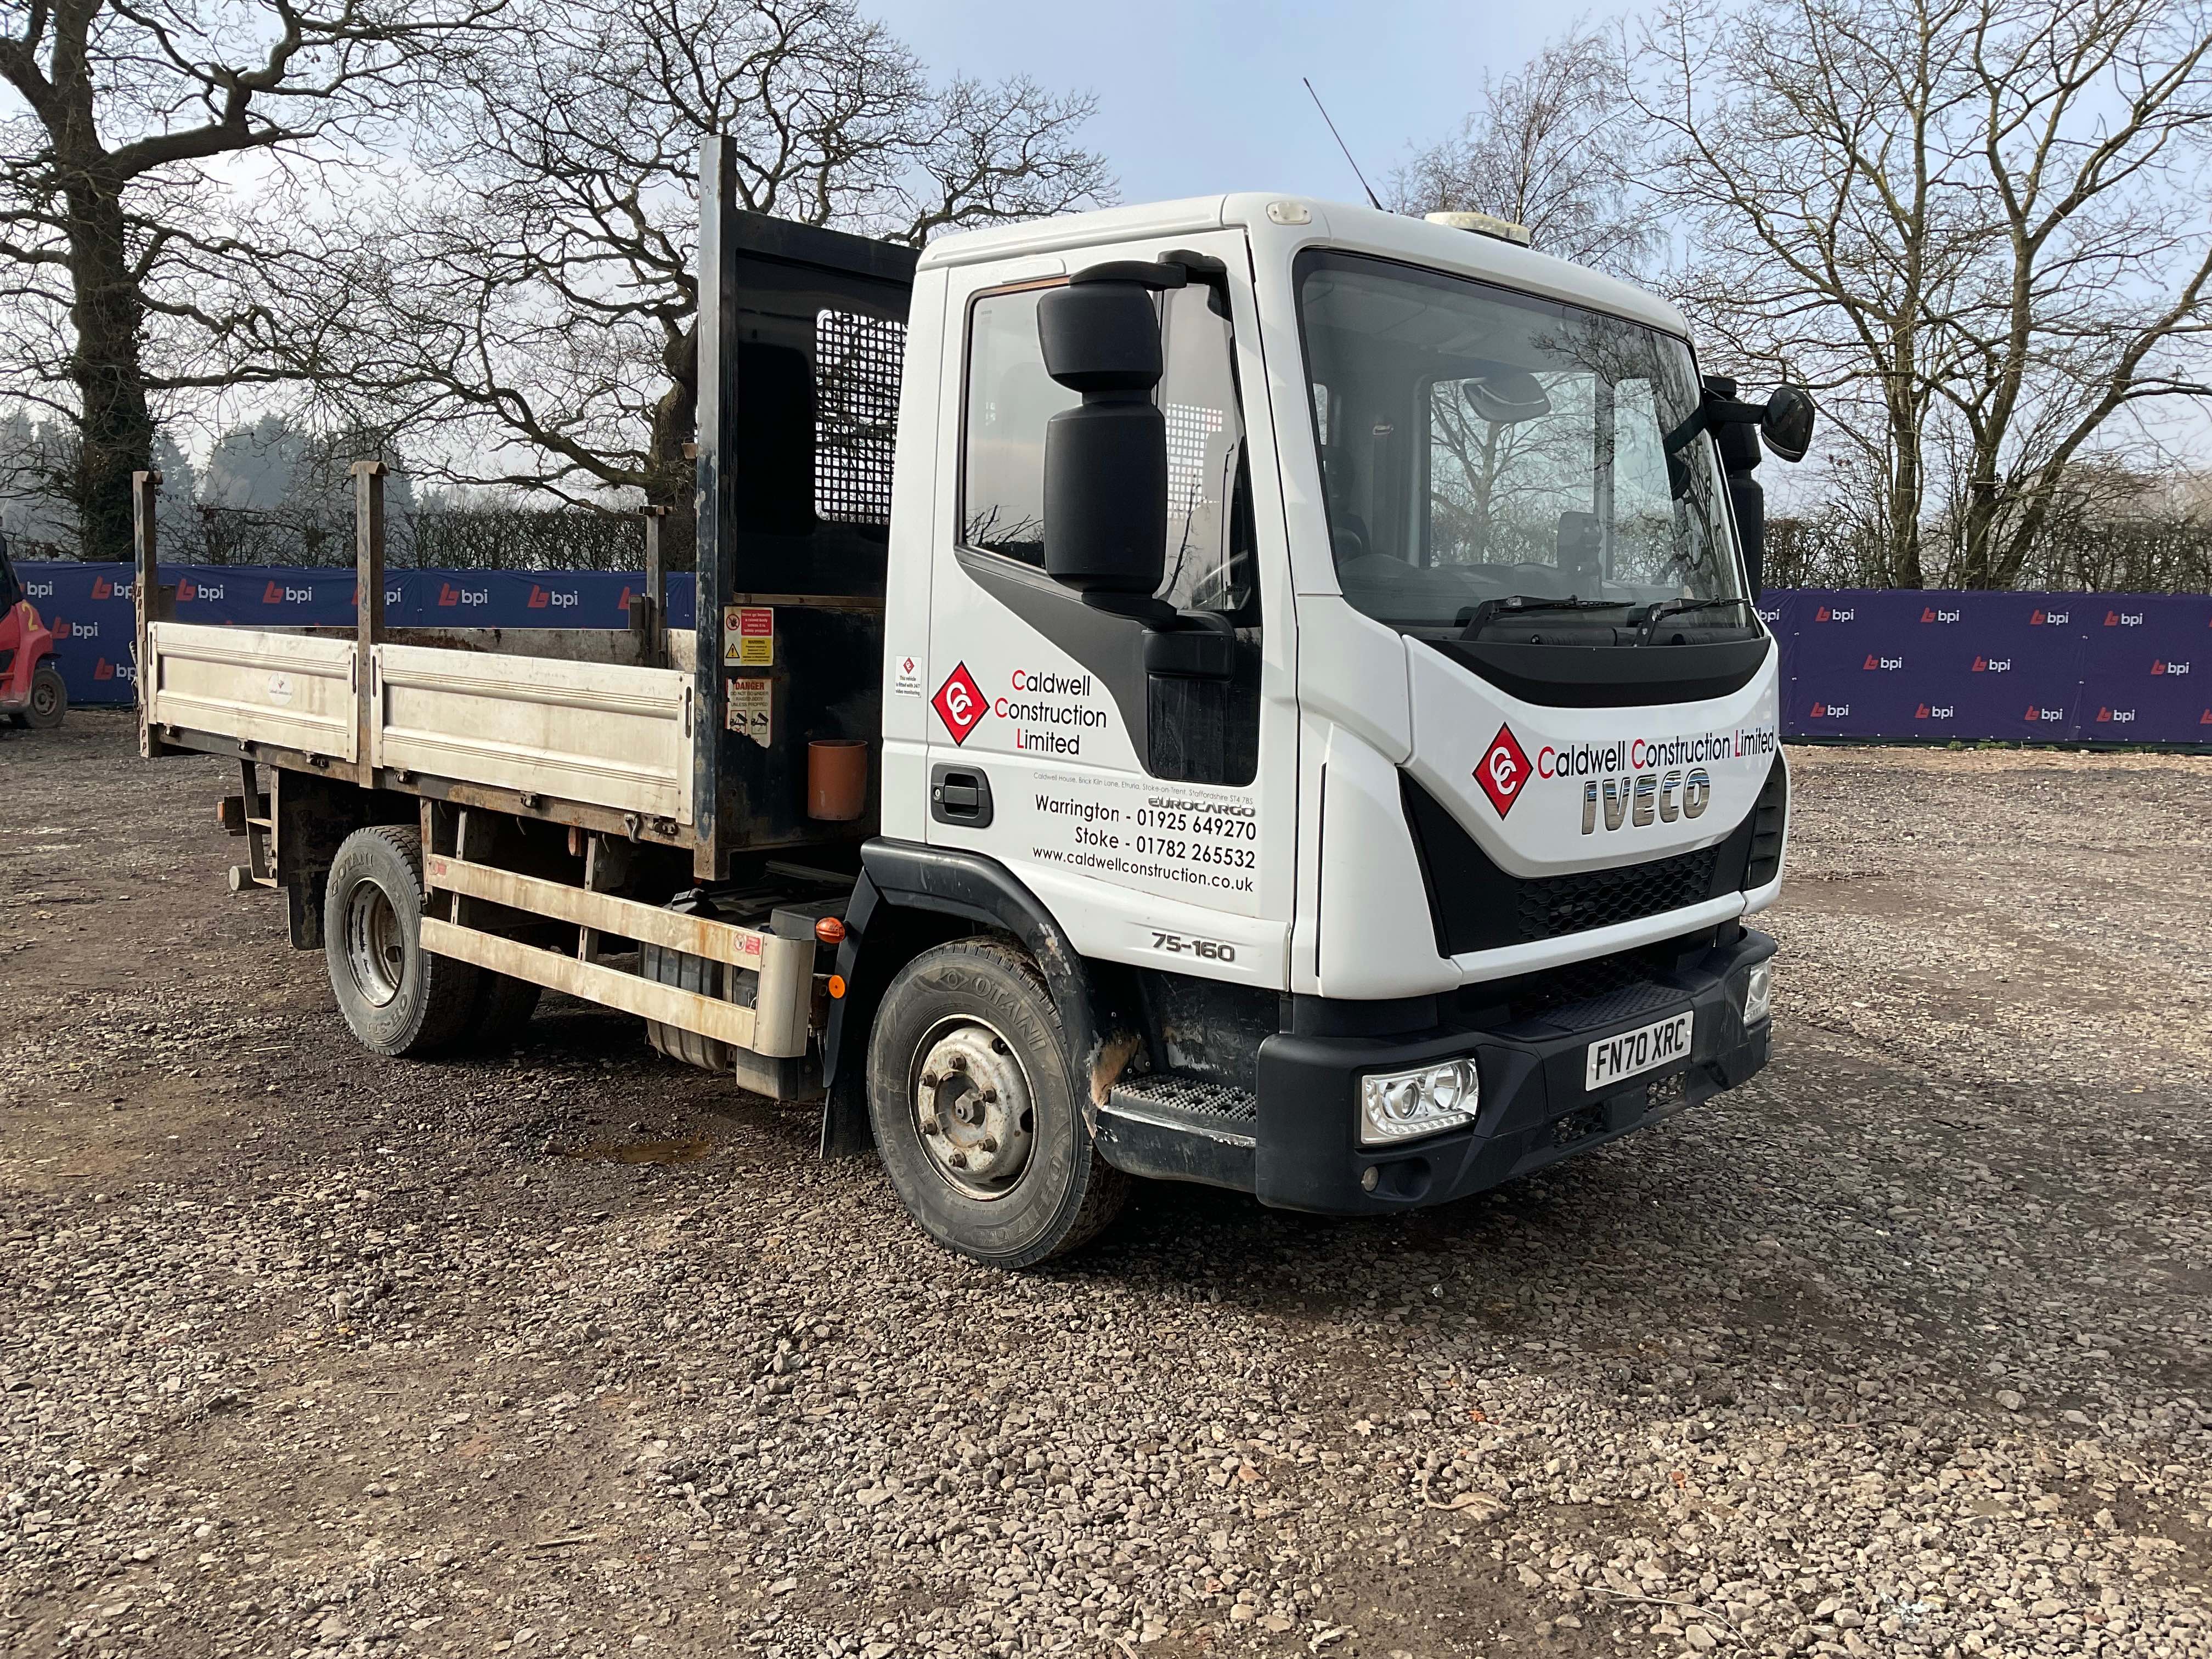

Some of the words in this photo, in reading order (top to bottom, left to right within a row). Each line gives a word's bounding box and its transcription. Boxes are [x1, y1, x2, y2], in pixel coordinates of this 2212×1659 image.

[27, 581, 53, 598] bpi
[114, 582, 133, 599] bp
[198, 584, 224, 601] bpi
[286, 586, 312, 603] bpi
[384, 588, 401, 605] pi
[461, 589, 488, 606] bpi
[551, 591, 578, 608] bpi
[21, 602, 38, 631] 2
[1759, 608, 1780, 622] bpi
[1832, 608, 1854, 623] bpi
[1938, 610, 1960, 623] bpi
[2047, 612, 2069, 625] bpi
[2121, 613, 2143, 627] bpi
[72, 622, 98, 639] bpi
[116, 663, 137, 680] bp
[1881, 657, 1902, 670] bpi
[1989, 659, 2011, 673] bpi
[2168, 662, 2190, 675] bpi
[736, 682, 764, 690] DANGER
[1012, 669, 1090, 696] Caldwell
[995, 697, 1107, 727] Construction
[1827, 704, 1849, 718] bpi
[1932, 706, 1954, 719] bpi
[2041, 708, 2063, 722] bpi
[2113, 709, 2135, 723] bpi
[1017, 728, 1080, 755] Limited
[1538, 741, 1625, 779] Caldwell
[1632, 732, 1730, 769] Construction
[1735, 726, 1774, 757] Limited
[1034, 772, 1057, 781] Caldwell
[1121, 781, 1141, 791] Etruria,
[1189, 789, 1228, 802] Staffordshire
[1148, 796, 1256, 817] EUROCARGO
[1582, 768, 1710, 835] IVECO
[1036, 794, 1119, 822] Warrington
[1137, 809, 1186, 831] 01925
[1193, 816, 1256, 840] 649270
[1075, 827, 1119, 849] Stoke
[1137, 836, 1186, 859] 01782
[1192, 843, 1255, 869] 265532
[1032, 847, 1254, 892] www.caldwellconstruction.co.uk
[1152, 932, 1234, 962] 75-160
[972, 977, 1047, 1052] OTANI
[1596, 1032, 1647, 1080] FN70
[1651, 1018, 1685, 1061] XRC
